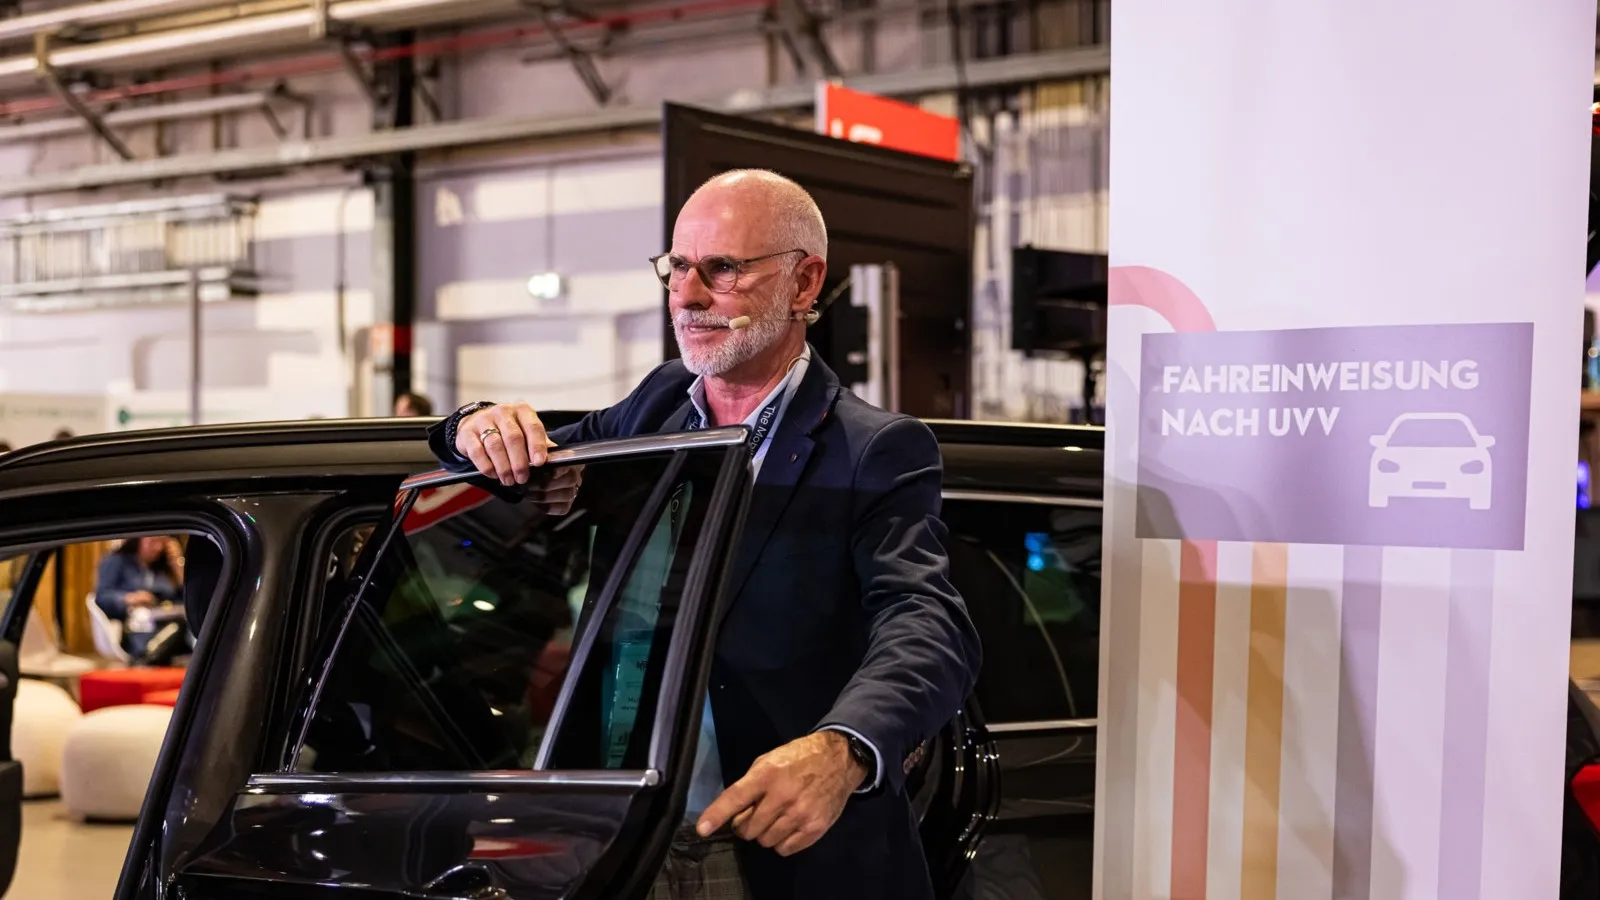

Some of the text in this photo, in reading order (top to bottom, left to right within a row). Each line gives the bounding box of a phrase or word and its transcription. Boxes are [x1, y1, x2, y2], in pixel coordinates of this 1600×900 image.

[1162, 359, 1479, 394] FAHREINWEISUNG
[749, 405, 777, 456] The Mob
[1161, 406, 1340, 437] NACH UVV
